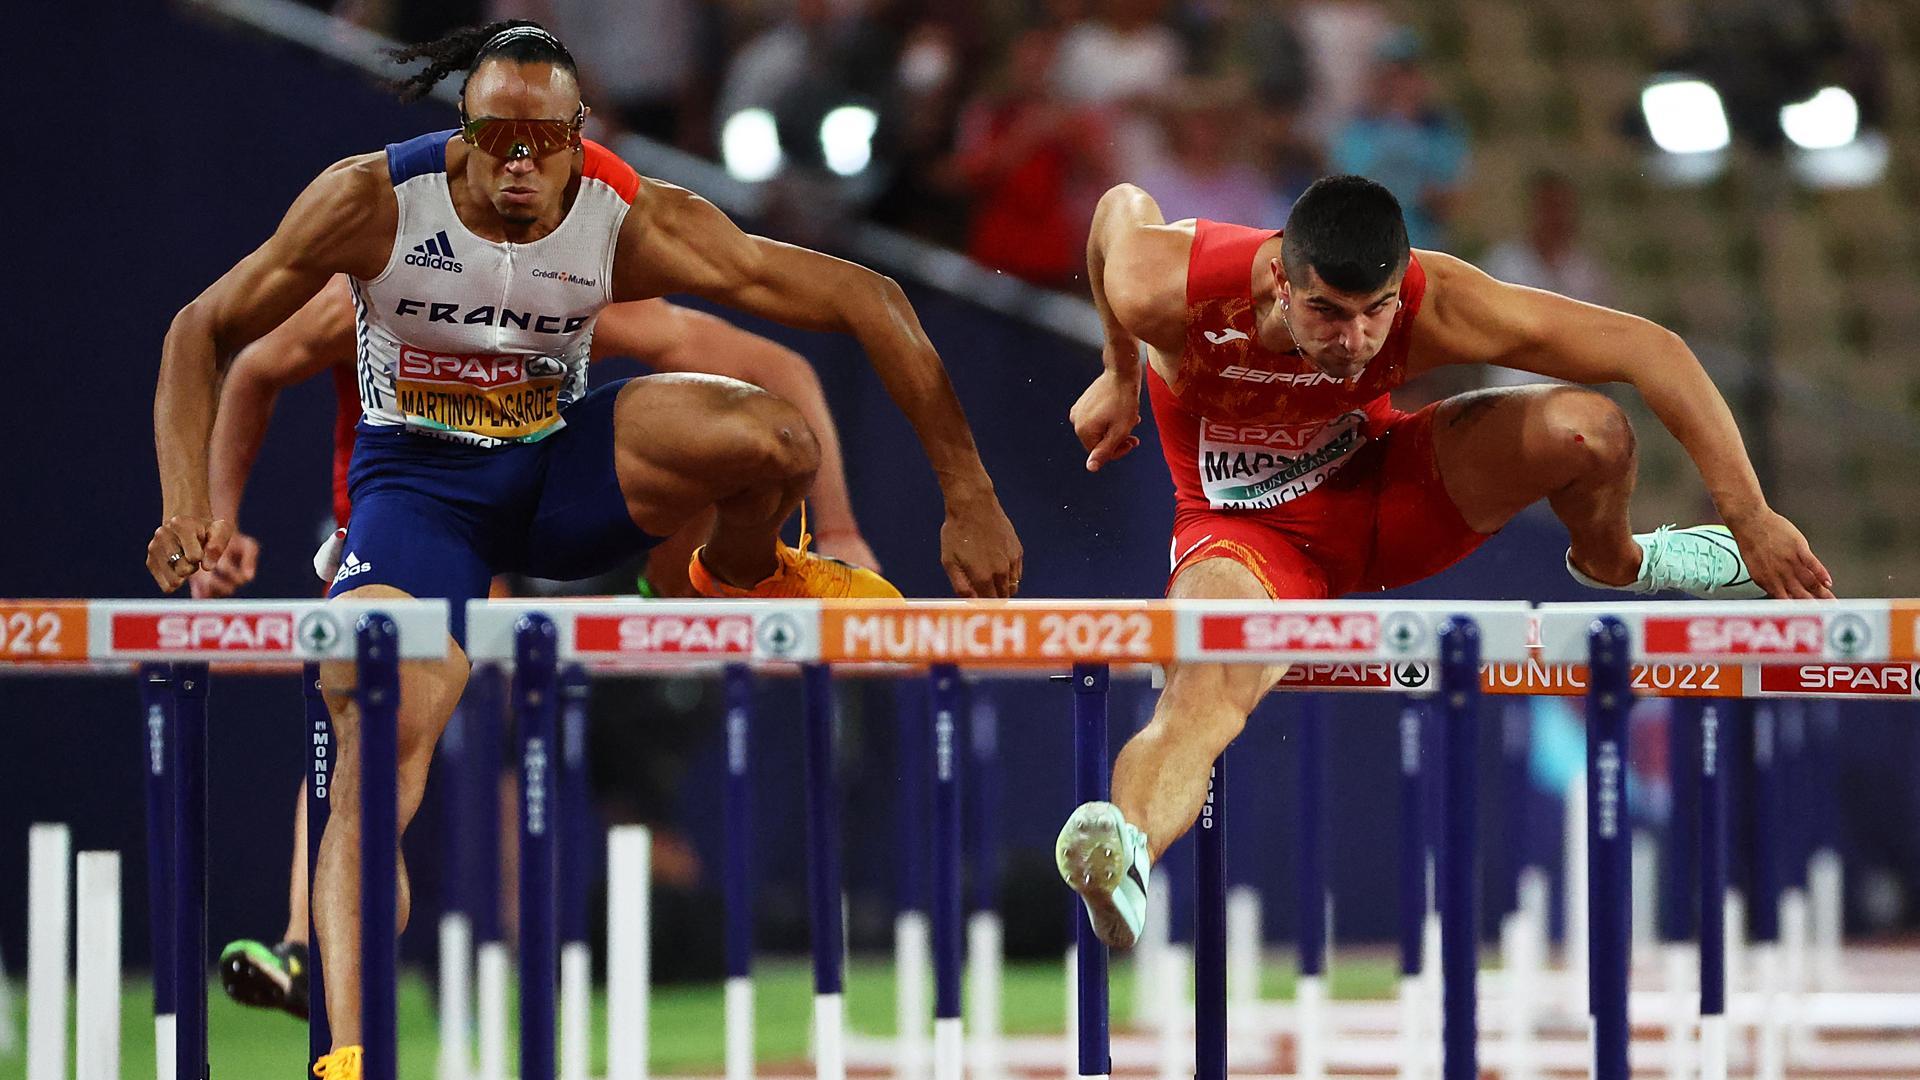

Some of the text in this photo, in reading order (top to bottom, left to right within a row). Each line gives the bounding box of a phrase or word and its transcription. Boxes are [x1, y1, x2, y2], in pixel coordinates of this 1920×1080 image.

[404, 253, 463, 274] adidas
[532, 268, 596, 287] Crédit Mutuel
[395, 298, 590, 335] FRANCE
[403, 350, 519, 383] SPAR
[1254, 474, 1282, 495] RUN
[1285, 453, 1329, 480] CLEAN
[155, 613, 292, 649] SPAR
[617, 616, 751, 651] SPAR
[843, 613, 1154, 656] MUNICH 2022
[1241, 616, 1376, 651] SPAR
[1686, 617, 1822, 653] SPAR
[1480, 658, 1720, 690] UNIC 2022
[1799, 665, 1908, 690] SPAR
[313, 732, 329, 799] MONDO
